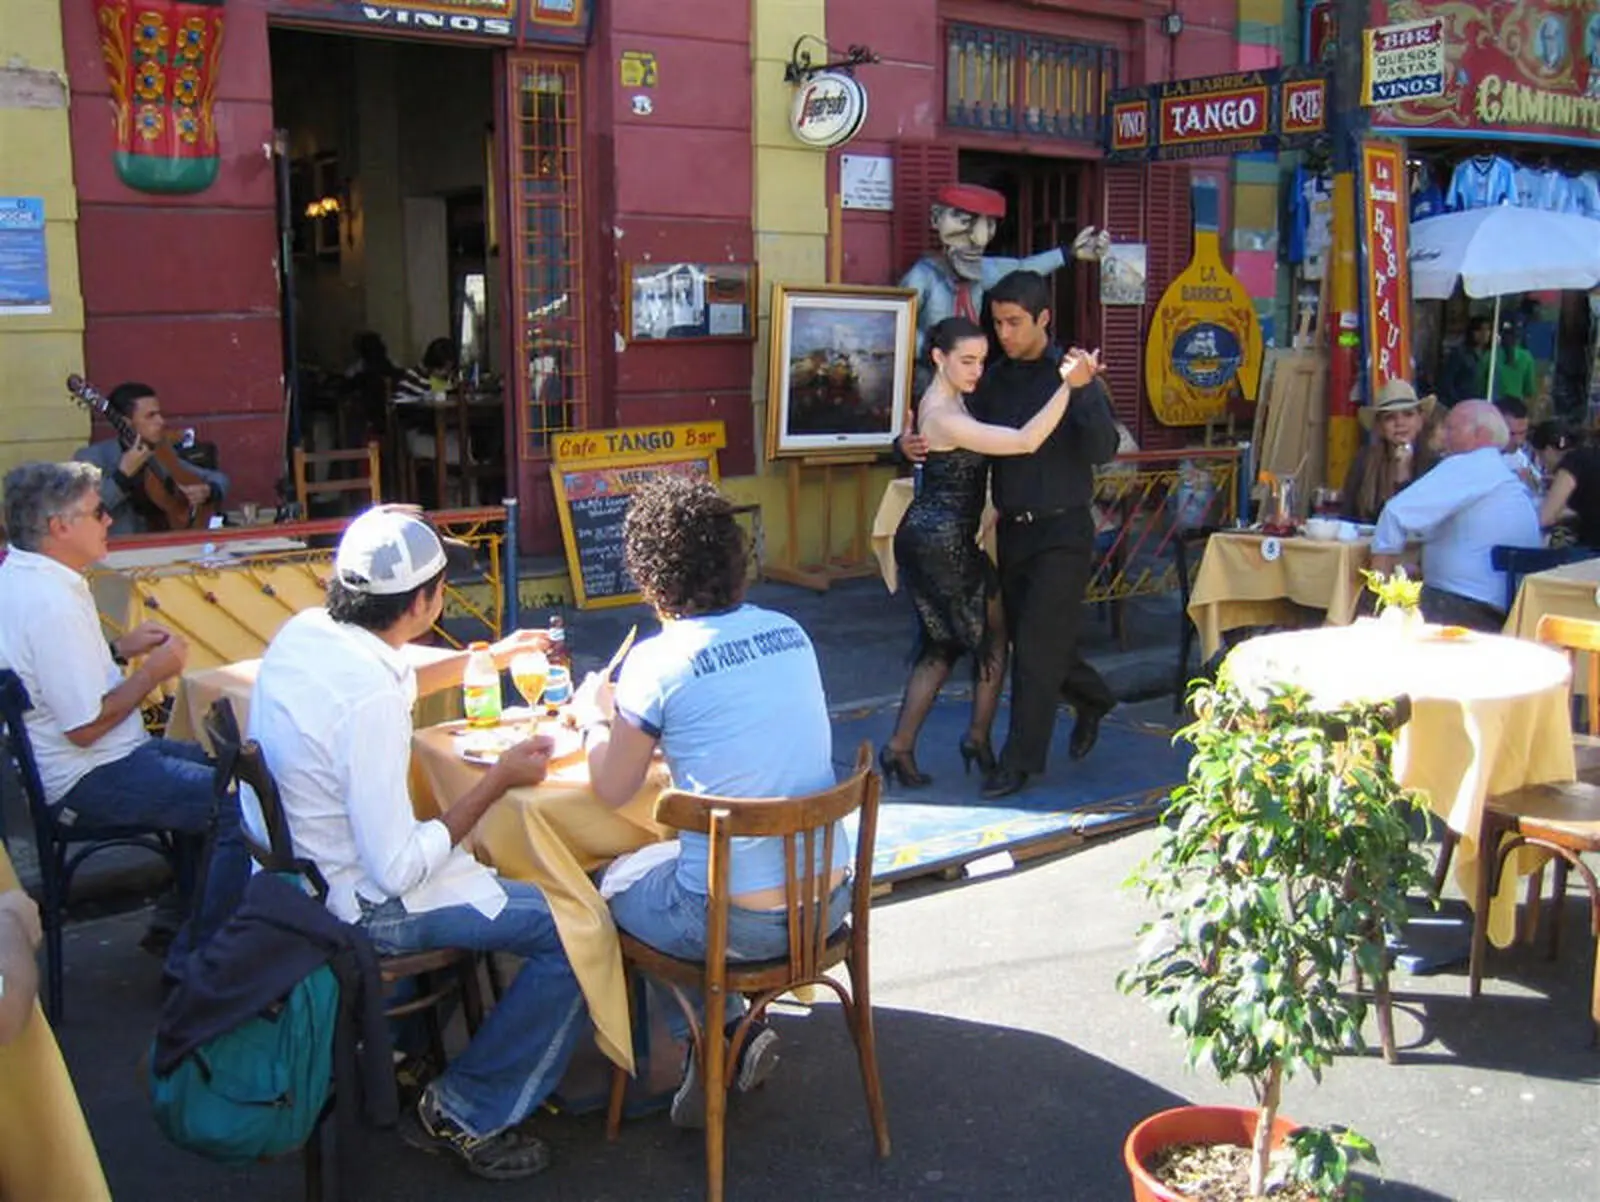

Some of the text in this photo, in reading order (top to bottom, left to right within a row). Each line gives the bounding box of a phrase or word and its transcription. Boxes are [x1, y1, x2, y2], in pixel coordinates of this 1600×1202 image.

[362, 6, 512, 34] VINOS
[1382, 27, 1433, 50] BAR
[1376, 49, 1437, 66] QUESOS
[1376, 59, 1438, 78] PASTAS
[1162, 70, 1265, 98] LA BARRICA
[1377, 75, 1438, 98] VINOS
[1170, 97, 1257, 136] TANGO
[1288, 88, 1322, 124] ARTE
[1117, 110, 1146, 138] VINO
[1200, 265, 1217, 282] LA
[1181, 284, 1233, 301] BARRICA
[559, 427, 717, 459] Cafe TANGO Bar
